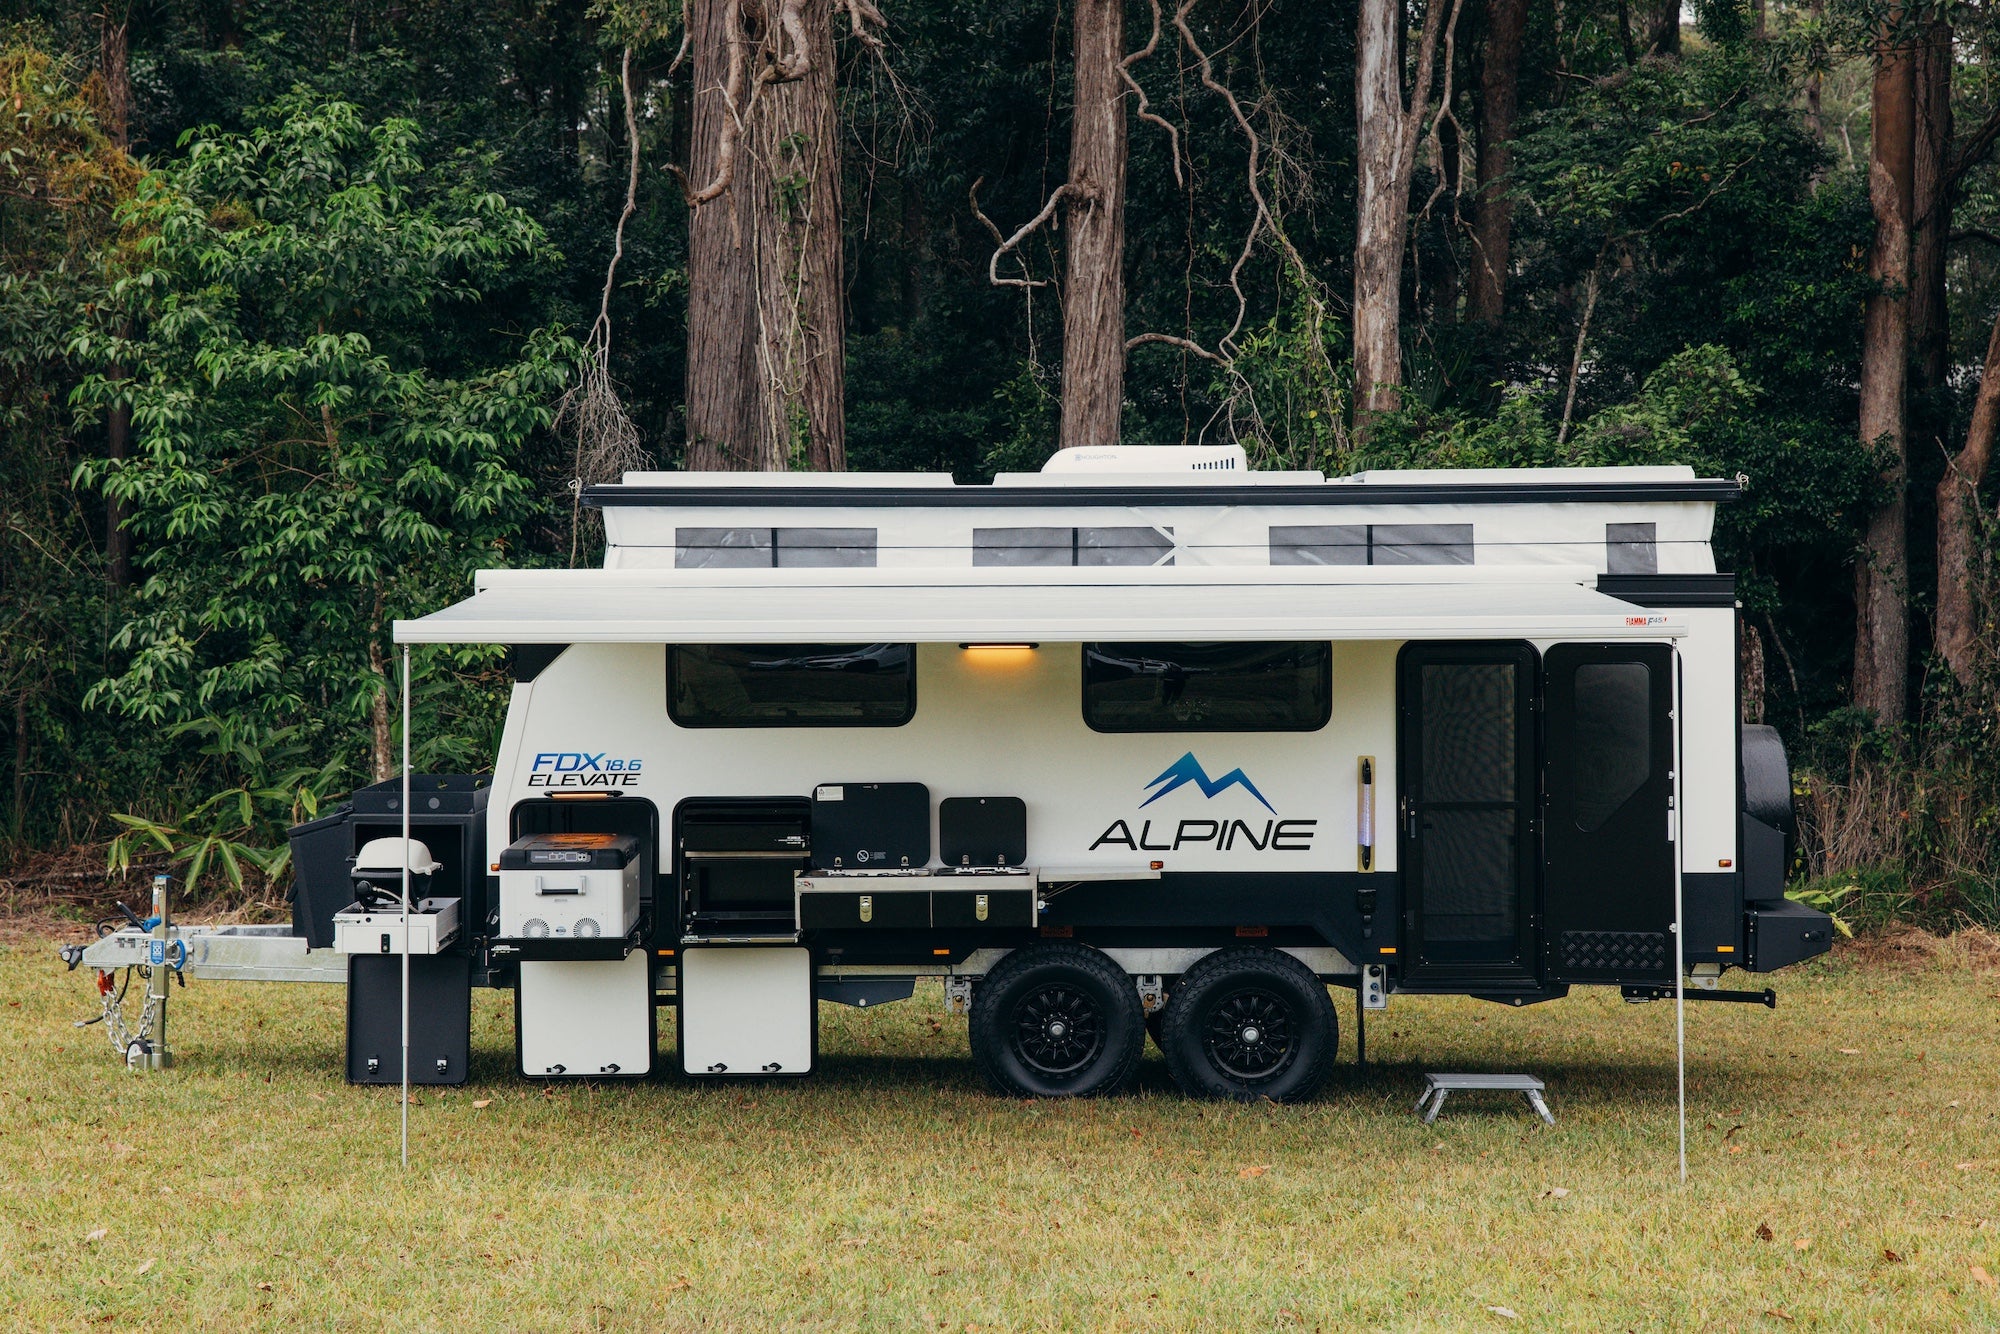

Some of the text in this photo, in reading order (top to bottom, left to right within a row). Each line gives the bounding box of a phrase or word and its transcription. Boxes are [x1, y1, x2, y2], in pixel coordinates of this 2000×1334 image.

[532, 753, 643, 771] FDX 18.6
[528, 773, 641, 786] ELEVATE
[1088, 819, 1318, 851] ALPINE
